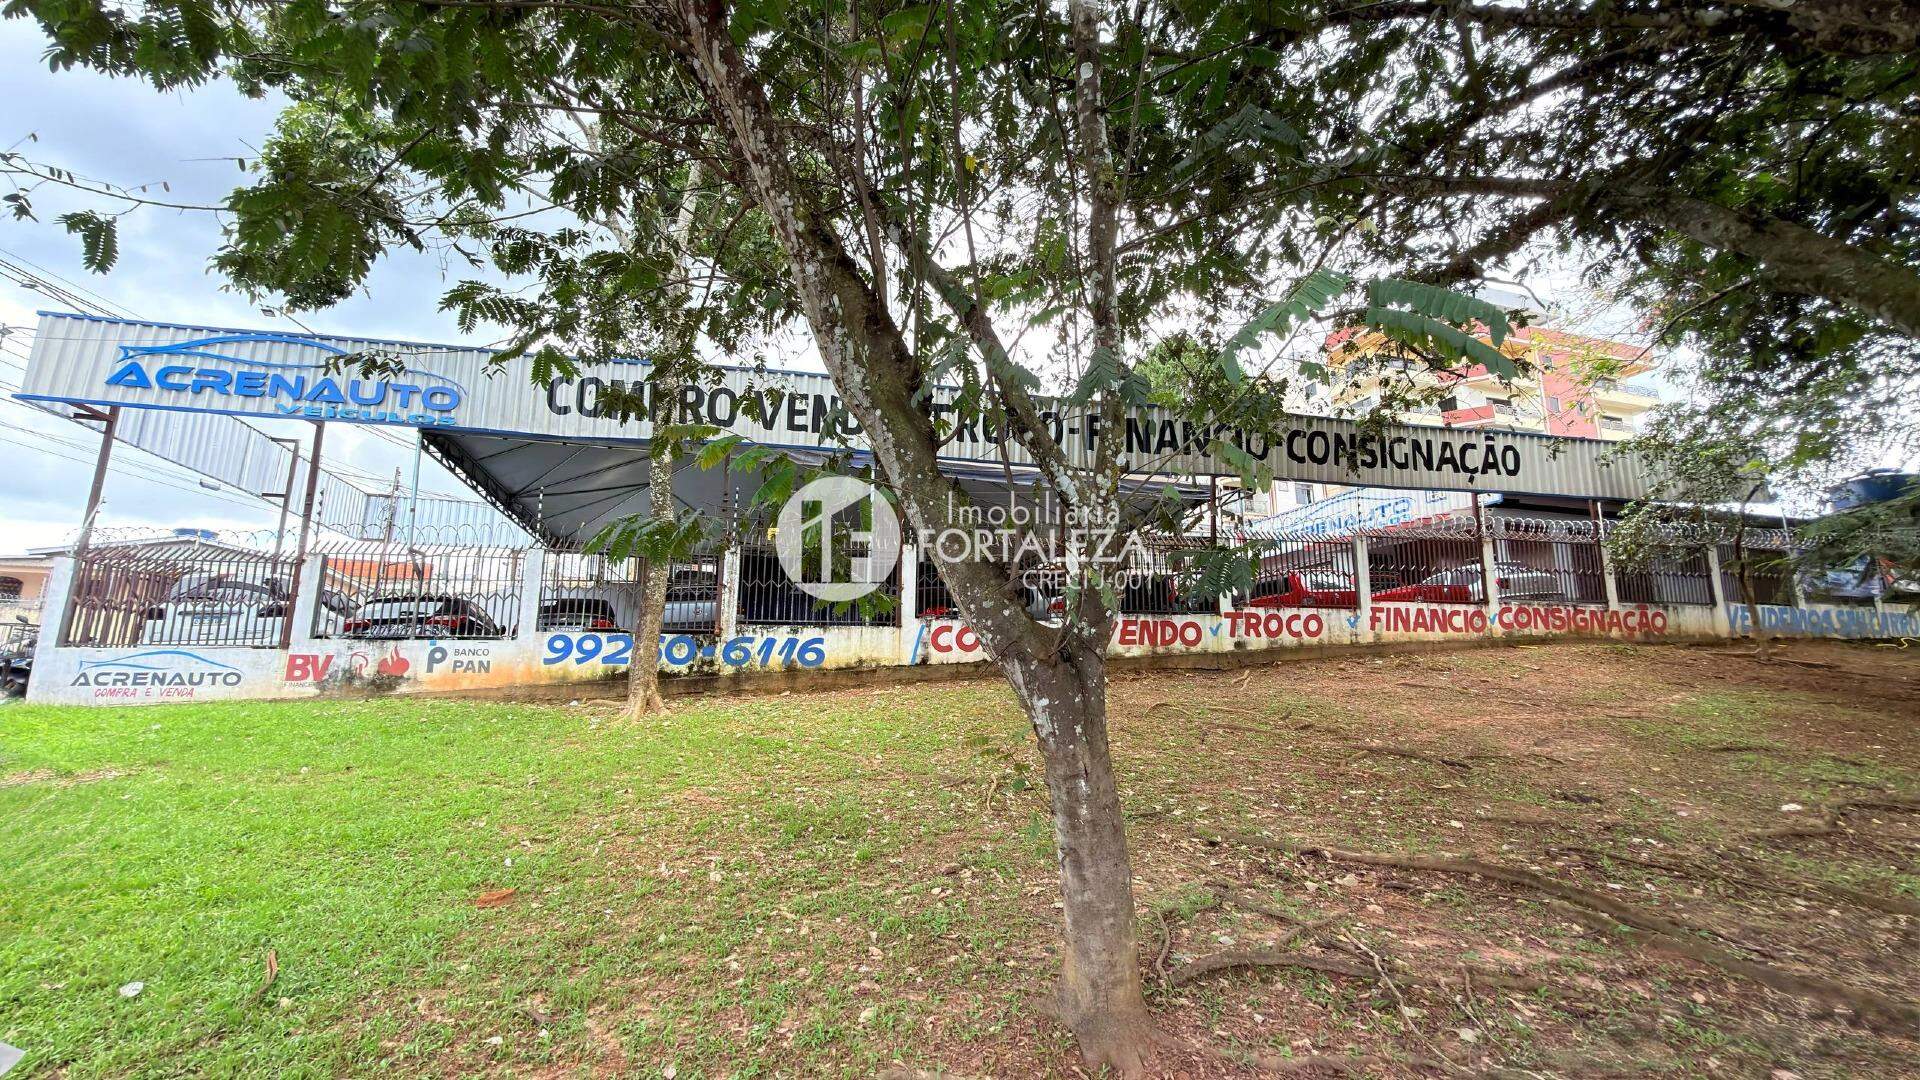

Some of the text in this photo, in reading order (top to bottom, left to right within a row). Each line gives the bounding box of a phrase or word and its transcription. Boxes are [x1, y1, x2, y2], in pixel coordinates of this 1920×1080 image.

[106, 361, 460, 412] ACRENAUTO
[1224, 611, 1324, 638] TROCO
[1369, 606, 1488, 634] FINANCIO
[453, 648, 490, 657] BANCO
[543, 634, 826, 668] 9920-6116
[285, 654, 335, 682] BV
[452, 659, 491, 673] PAN
[70, 672, 242, 687] ACRENAUTO
[94, 687, 195, 698] COMPRA E VENDA
